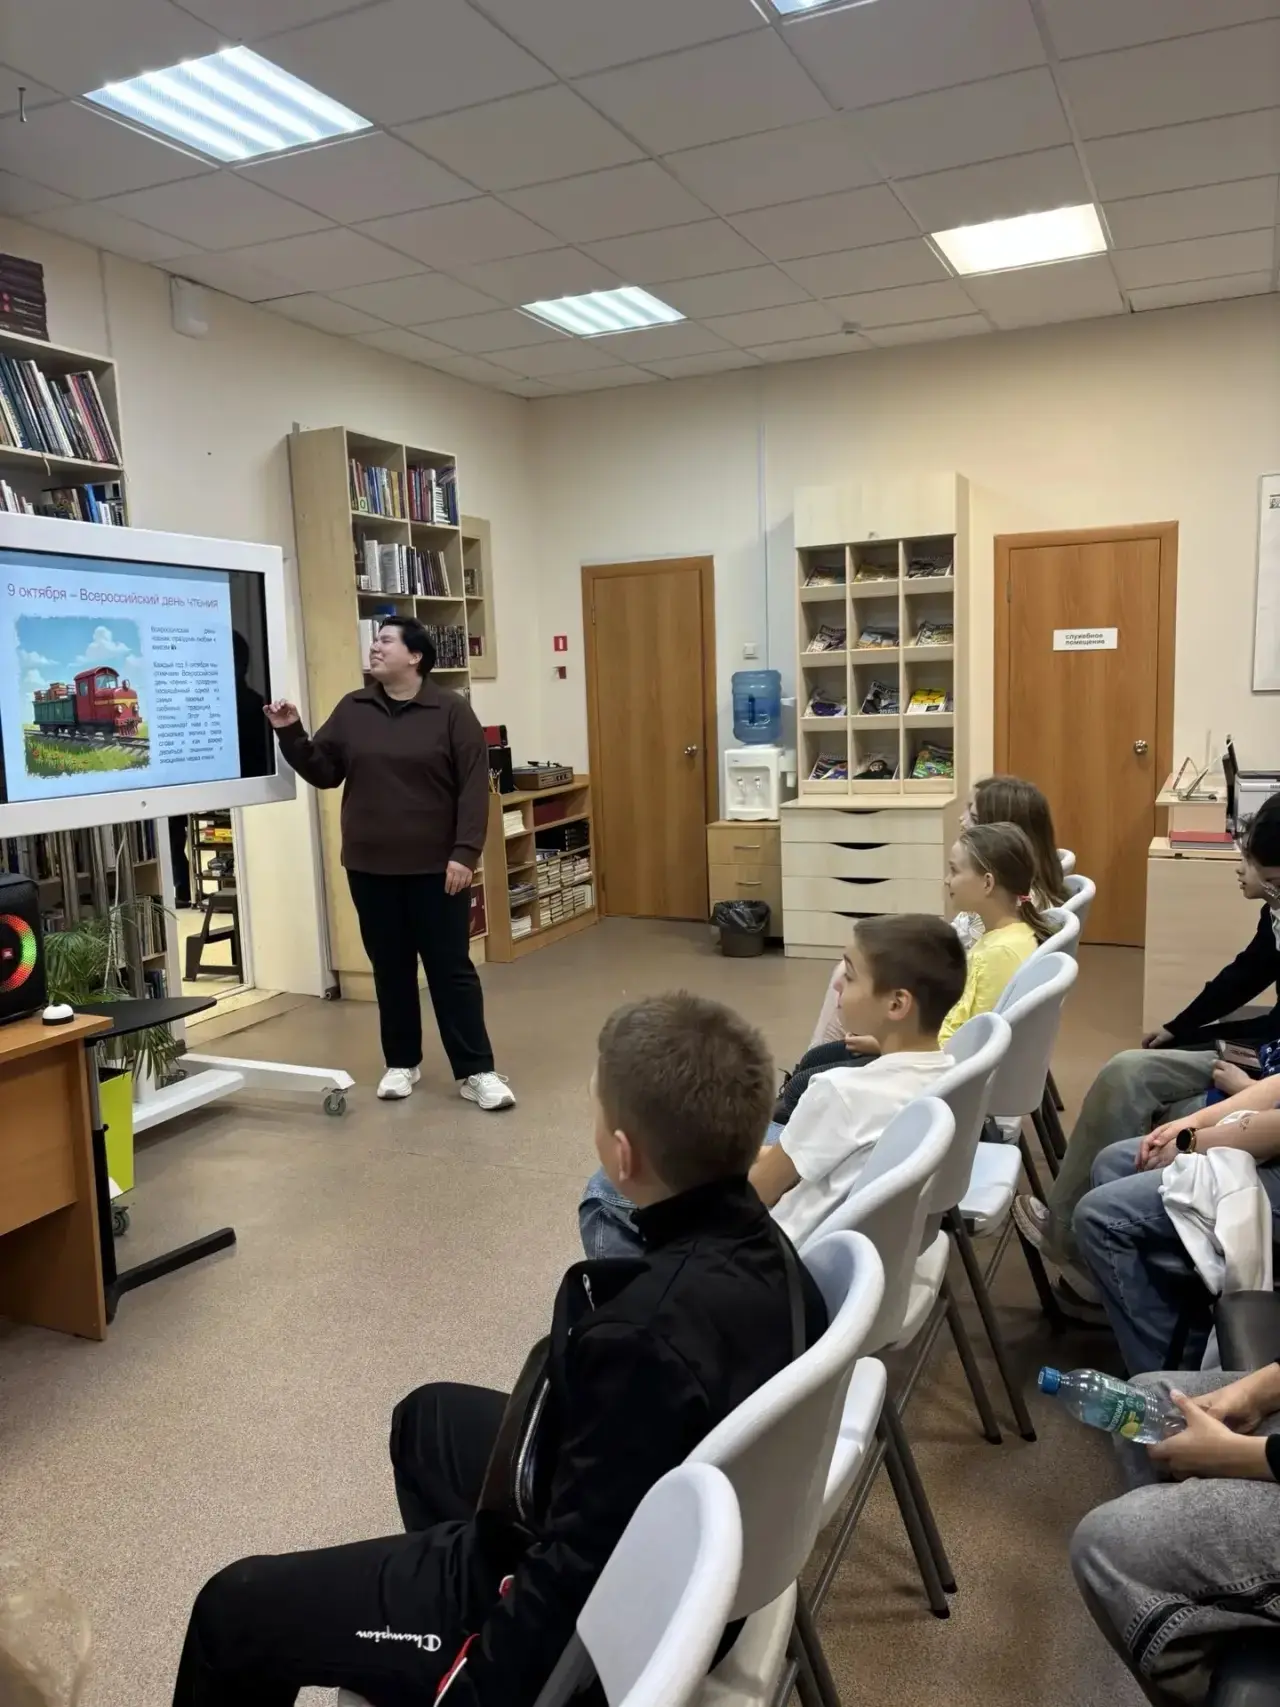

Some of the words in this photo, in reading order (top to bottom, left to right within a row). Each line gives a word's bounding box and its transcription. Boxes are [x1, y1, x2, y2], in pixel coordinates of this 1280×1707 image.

[7, 583, 15, 597] 9
[19, 585, 67, 603] октября
[80, 588, 159, 605] Всероссийский
[161, 596, 185, 607] день
[187, 599, 218, 610] чтения
[1065, 632, 1103, 640] служебное
[355, 1625, 441, 1652] Champion
